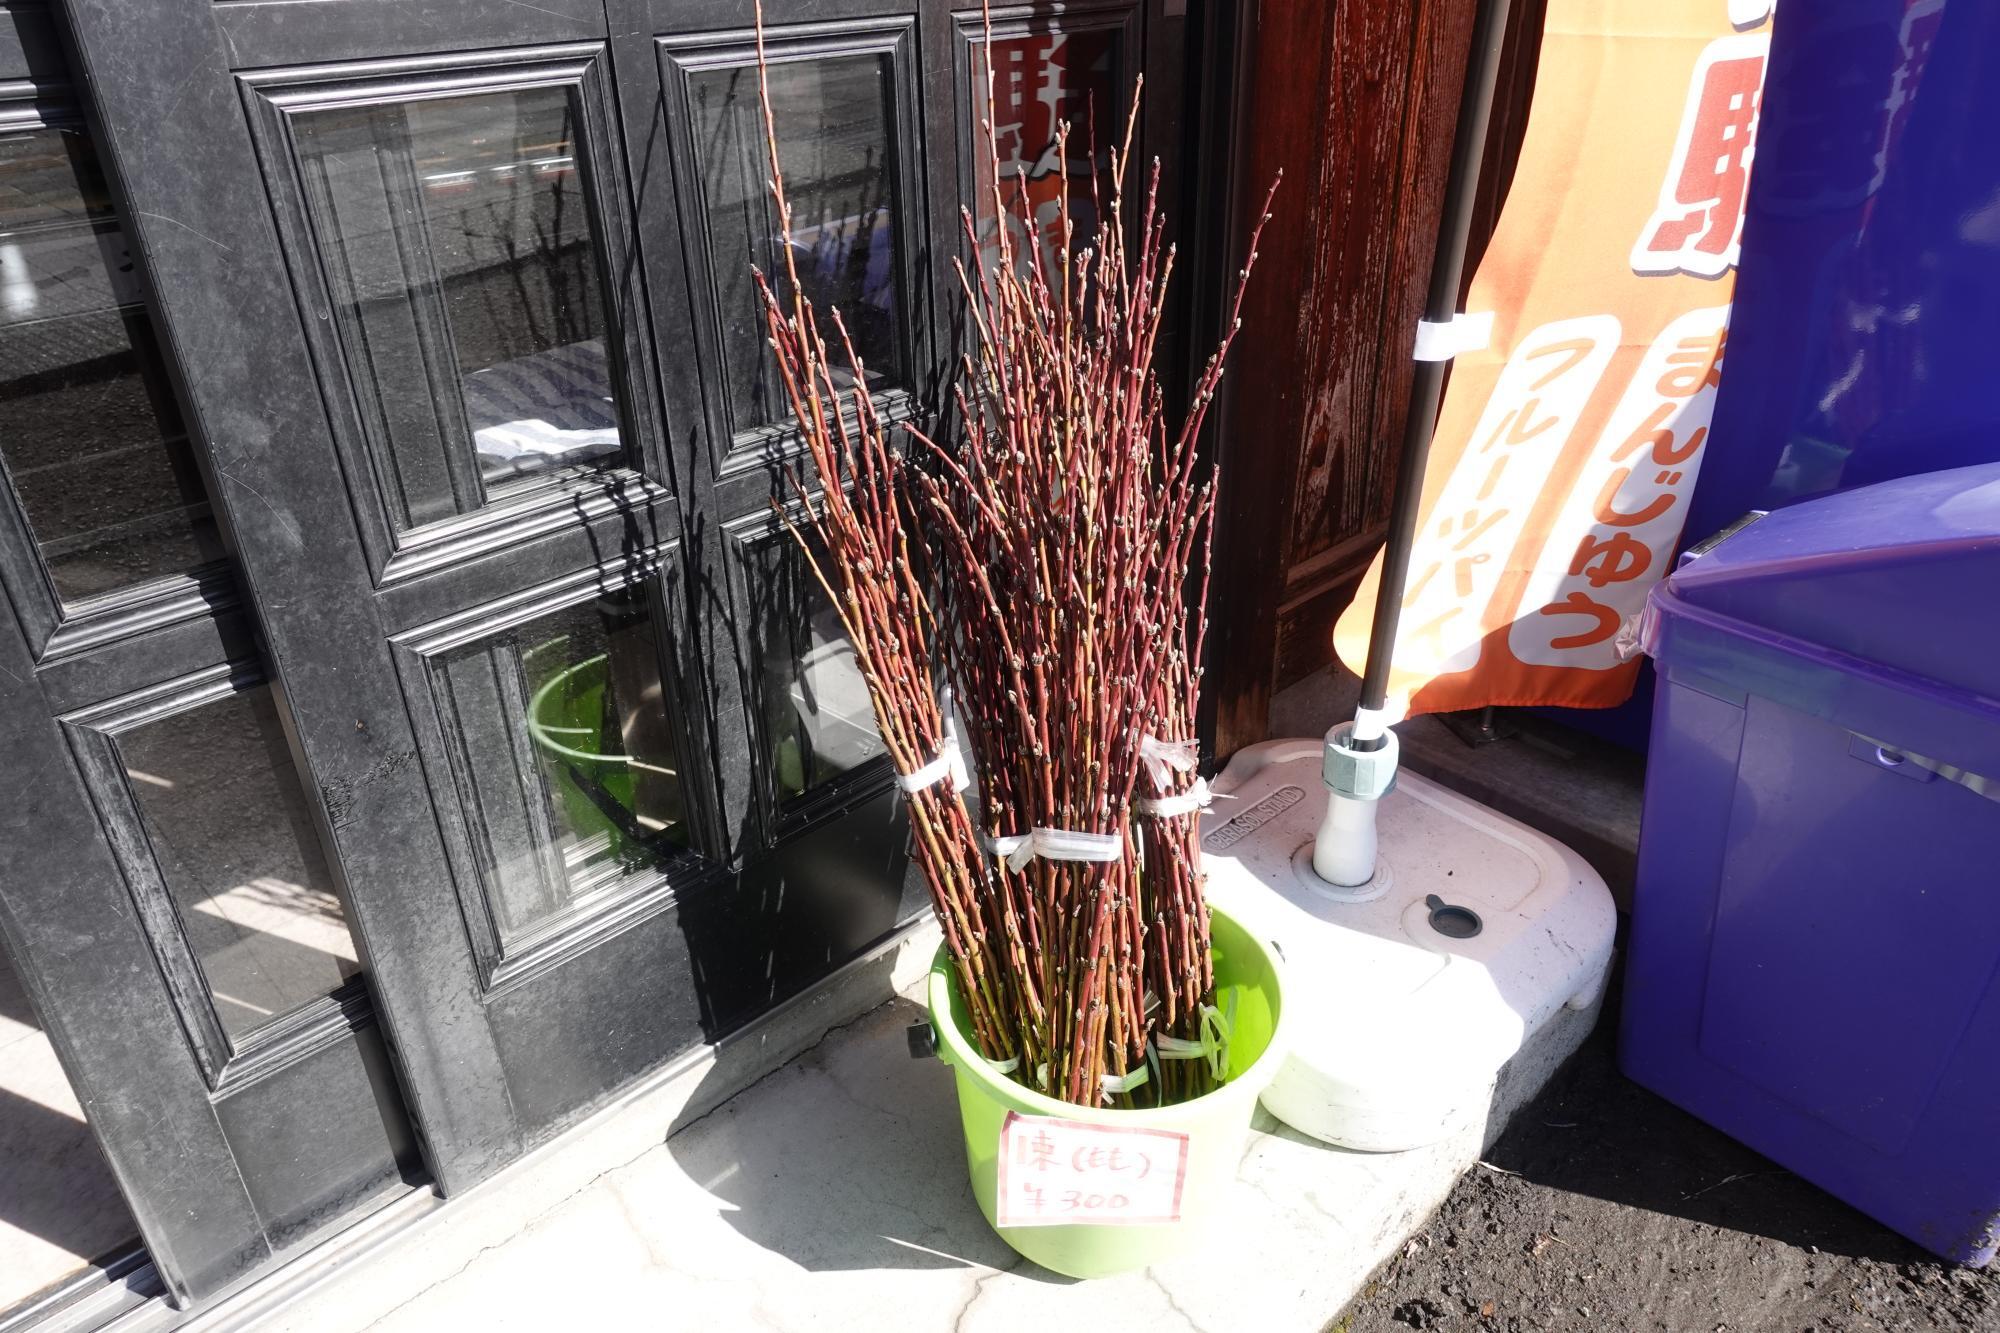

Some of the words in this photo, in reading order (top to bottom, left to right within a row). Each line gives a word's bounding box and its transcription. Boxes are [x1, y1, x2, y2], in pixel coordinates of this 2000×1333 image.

[1540, 326, 1728, 649] まんじゅう
[1207, 812, 1265, 849] PARASOL
[1257, 790, 1298, 816] STAND
